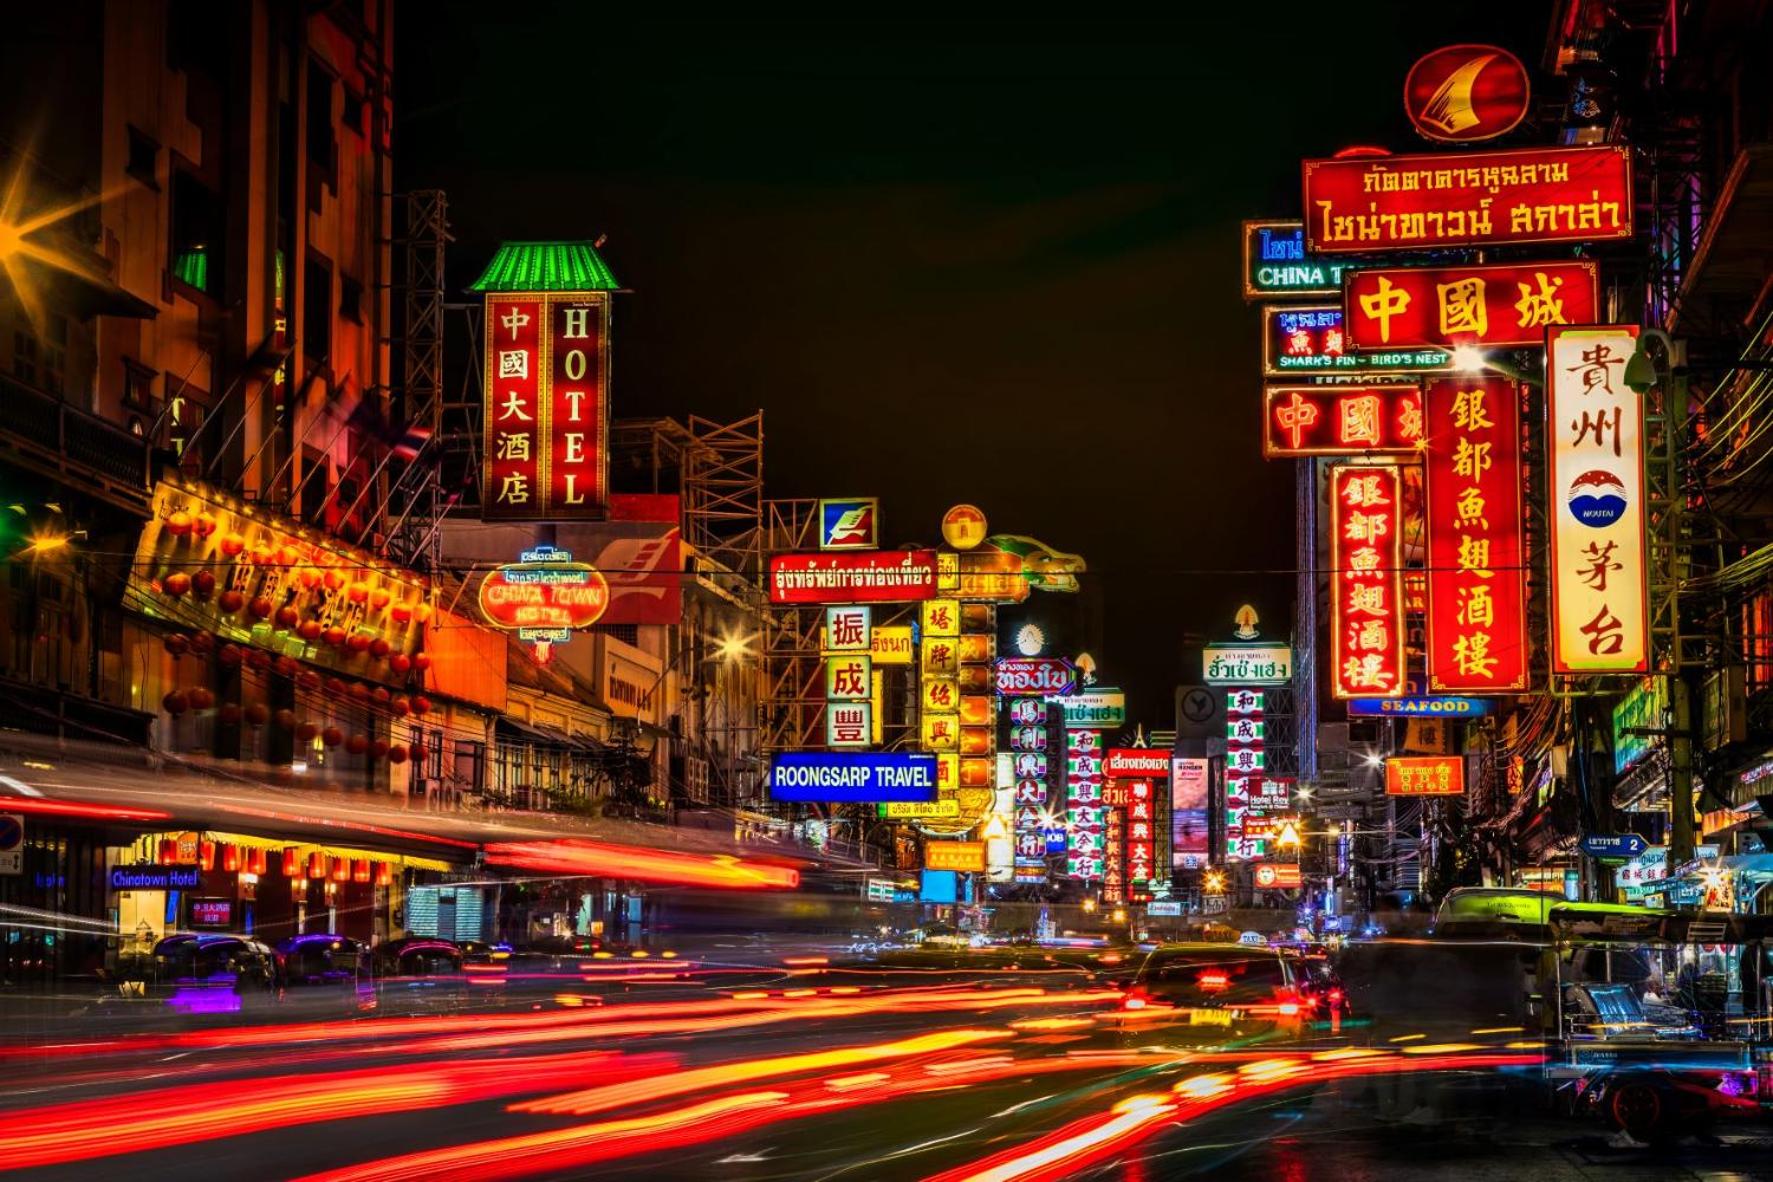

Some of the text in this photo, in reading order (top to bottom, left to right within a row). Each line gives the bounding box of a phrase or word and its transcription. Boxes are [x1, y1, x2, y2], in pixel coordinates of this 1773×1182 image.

[1258, 266, 1325, 286] CHINA
[1359, 271, 1567, 344] 中國城
[497, 306, 533, 505] 中國大酒店
[1279, 355, 1332, 367] SHARK'S
[1336, 354, 1356, 366] FIN
[1371, 353, 1412, 365] BIRD'S
[1416, 352, 1447, 364] NEST
[1566, 343, 1625, 457] 貴州
[563, 308, 590, 505] HOTEL
[1449, 388, 1500, 680] 銀都魚翅酒樓
[1341, 474, 1393, 690] 銀都魚翅酒樓
[1576, 539, 1624, 657] 茅台
[832, 611, 865, 742] 振成豐
[1381, 701, 1470, 712] SEAFOOD
[776, 766, 933, 788] ROONGSARP TRAVEL
[112, 870, 198, 887] Chinatown Hotel
[1630, 838, 1638, 850] 2
